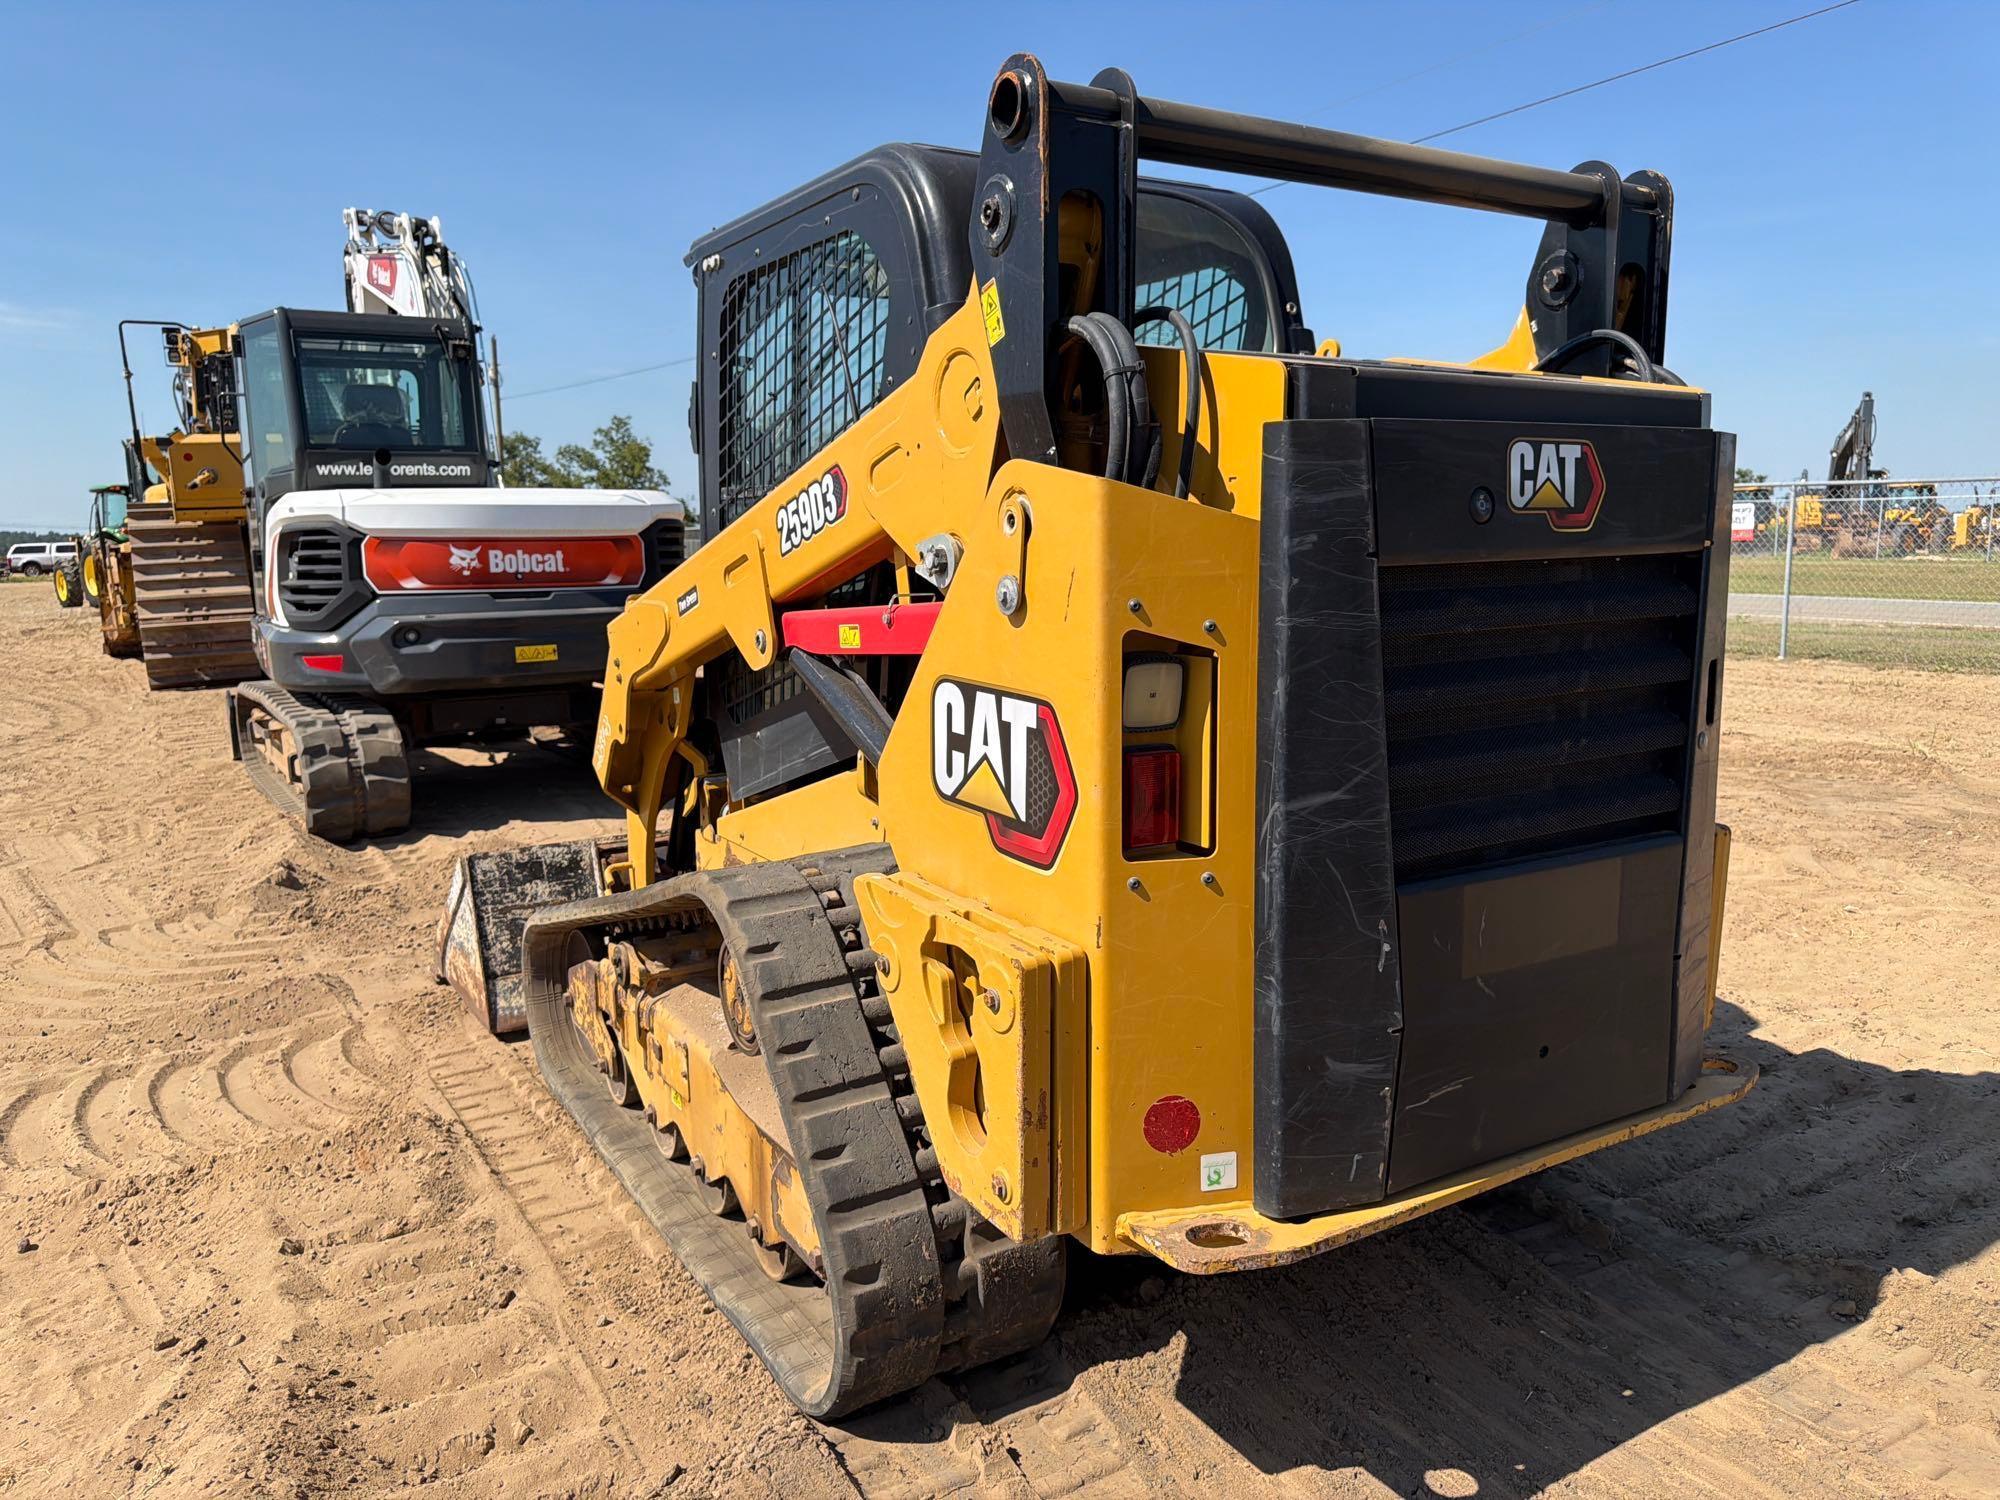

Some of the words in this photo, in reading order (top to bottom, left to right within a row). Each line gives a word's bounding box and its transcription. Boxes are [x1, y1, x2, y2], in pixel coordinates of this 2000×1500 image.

[316, 462, 471, 476] www.leorents.com
[1510, 441, 1582, 509] CAT
[776, 472, 838, 555] 259D3
[488, 549, 565, 574] Bobcat
[934, 681, 1039, 822] CAT
